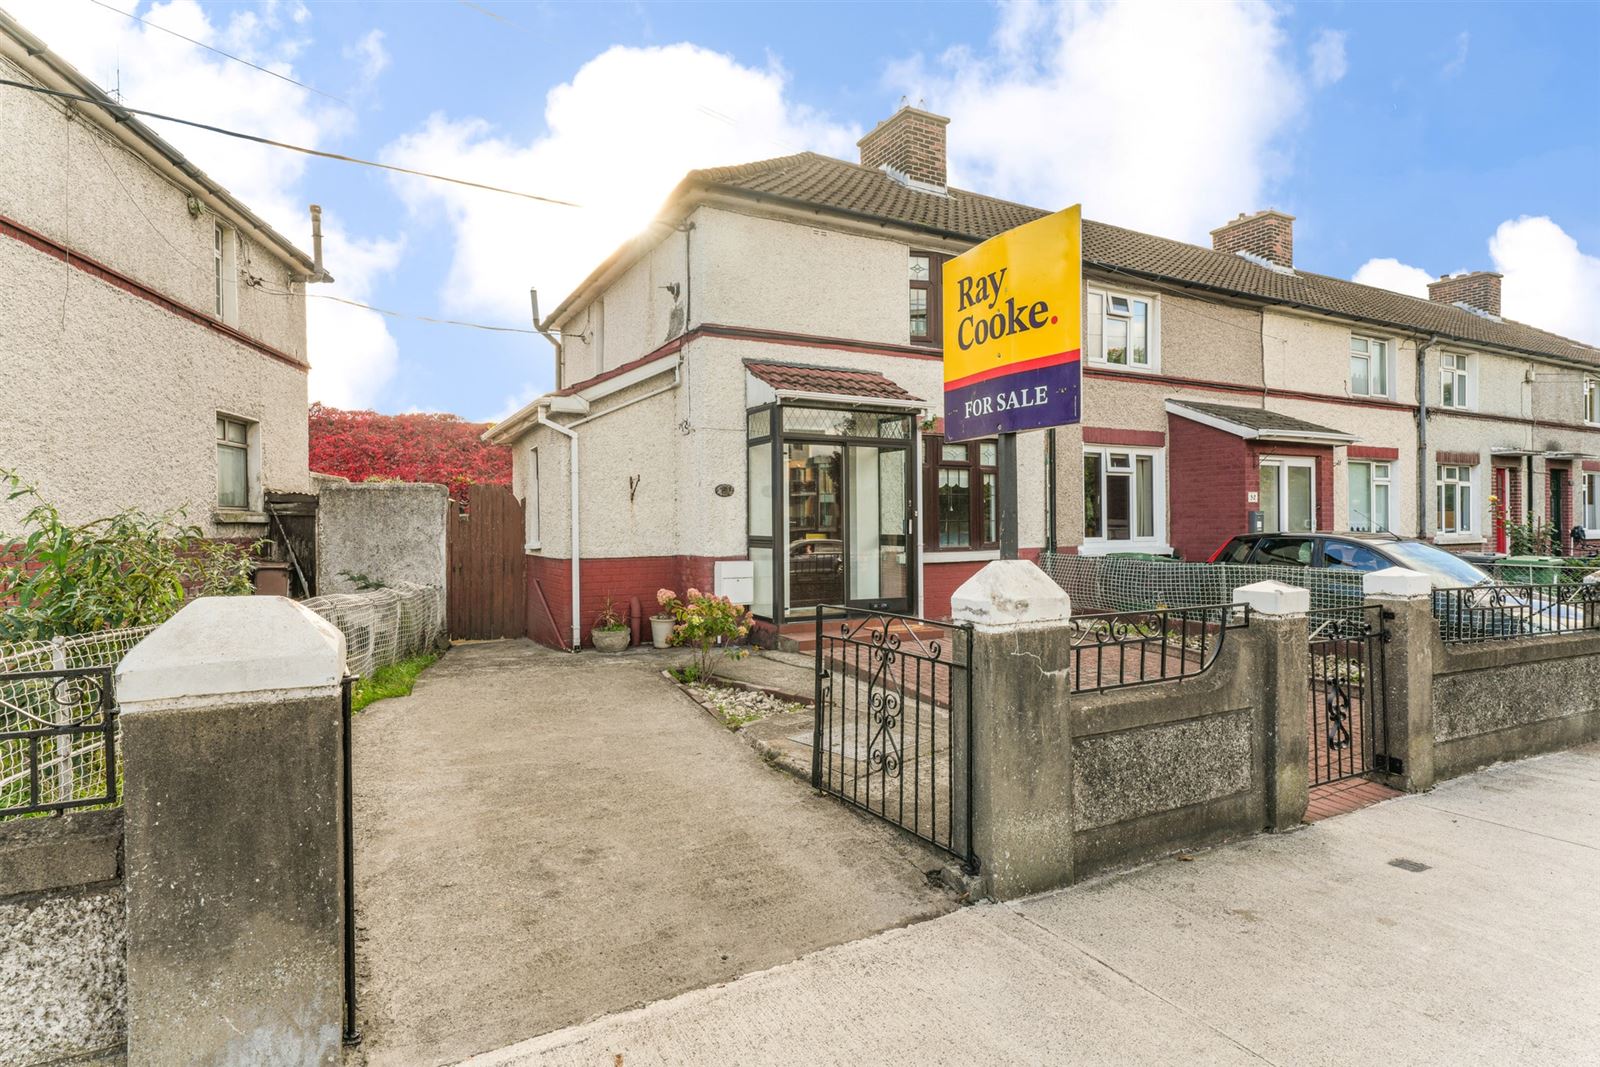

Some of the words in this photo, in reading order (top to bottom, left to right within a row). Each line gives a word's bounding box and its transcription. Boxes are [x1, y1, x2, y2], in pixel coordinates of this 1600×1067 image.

[957, 268, 1007, 312] Ray
[958, 298, 1058, 351] Cooke.
[964, 396, 993, 419] FOR
[997, 385, 1048, 412] SALE
